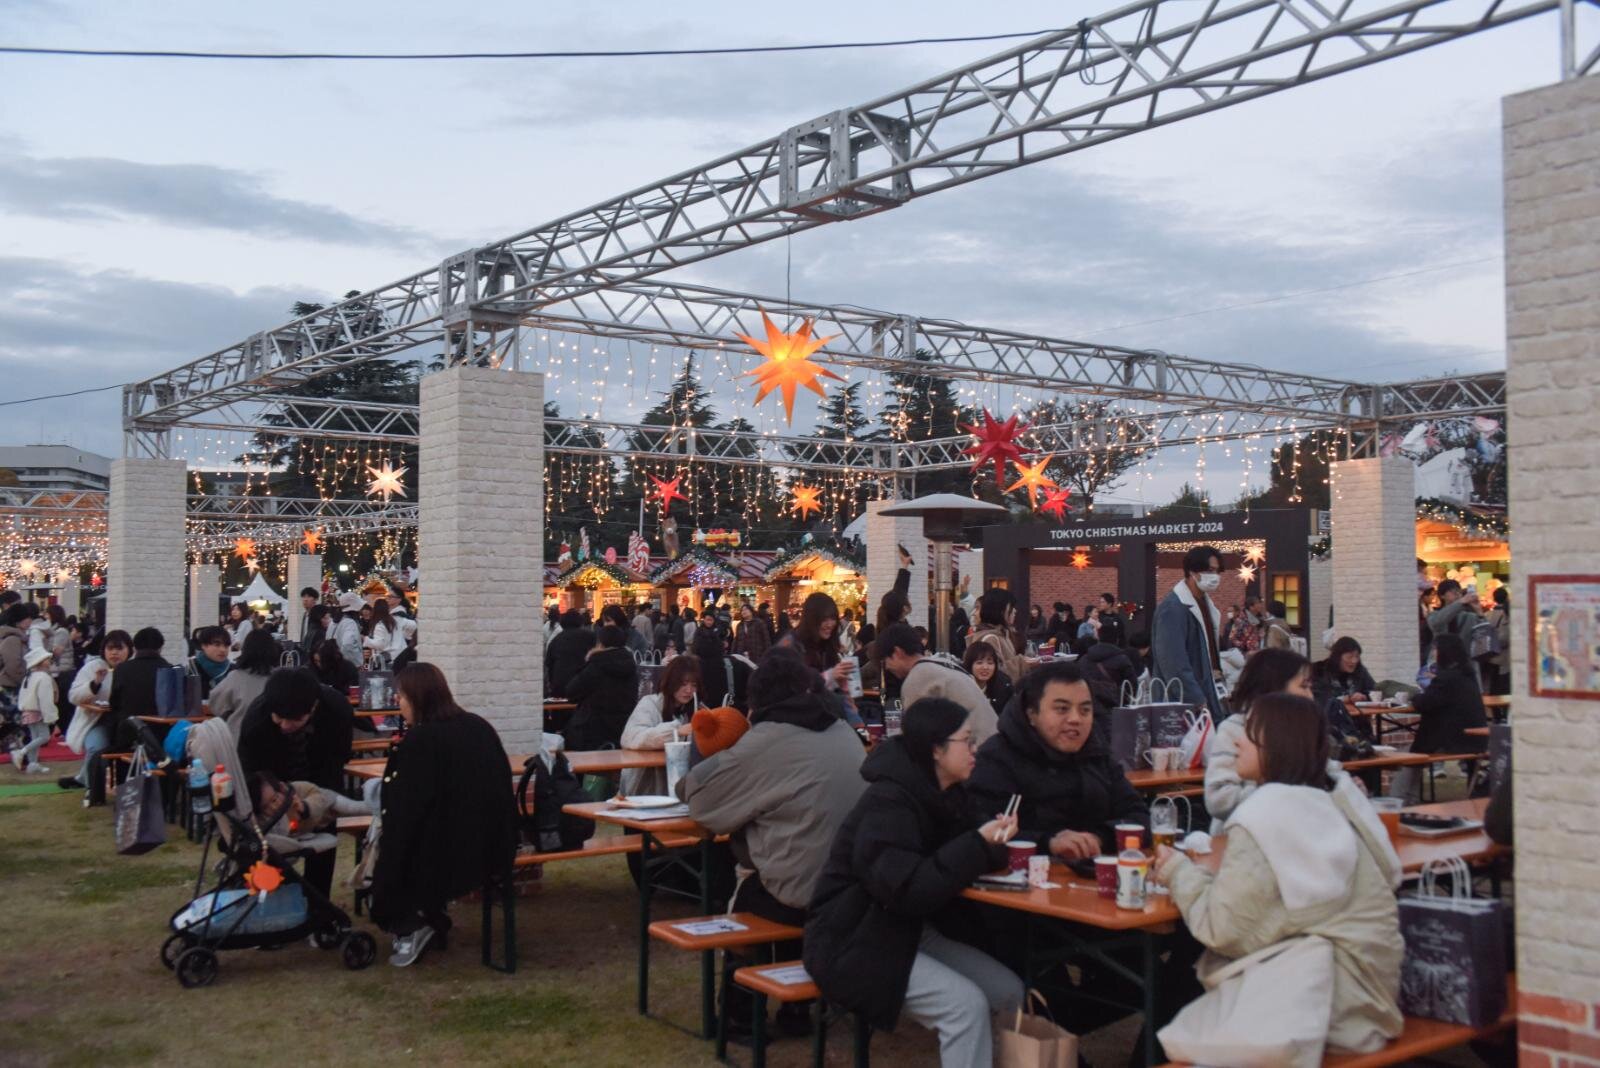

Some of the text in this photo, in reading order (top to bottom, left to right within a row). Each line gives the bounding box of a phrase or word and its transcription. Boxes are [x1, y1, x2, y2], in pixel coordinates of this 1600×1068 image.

[1050, 522, 1224, 540] TOKYO CHRISTMAS MARKET 2024
